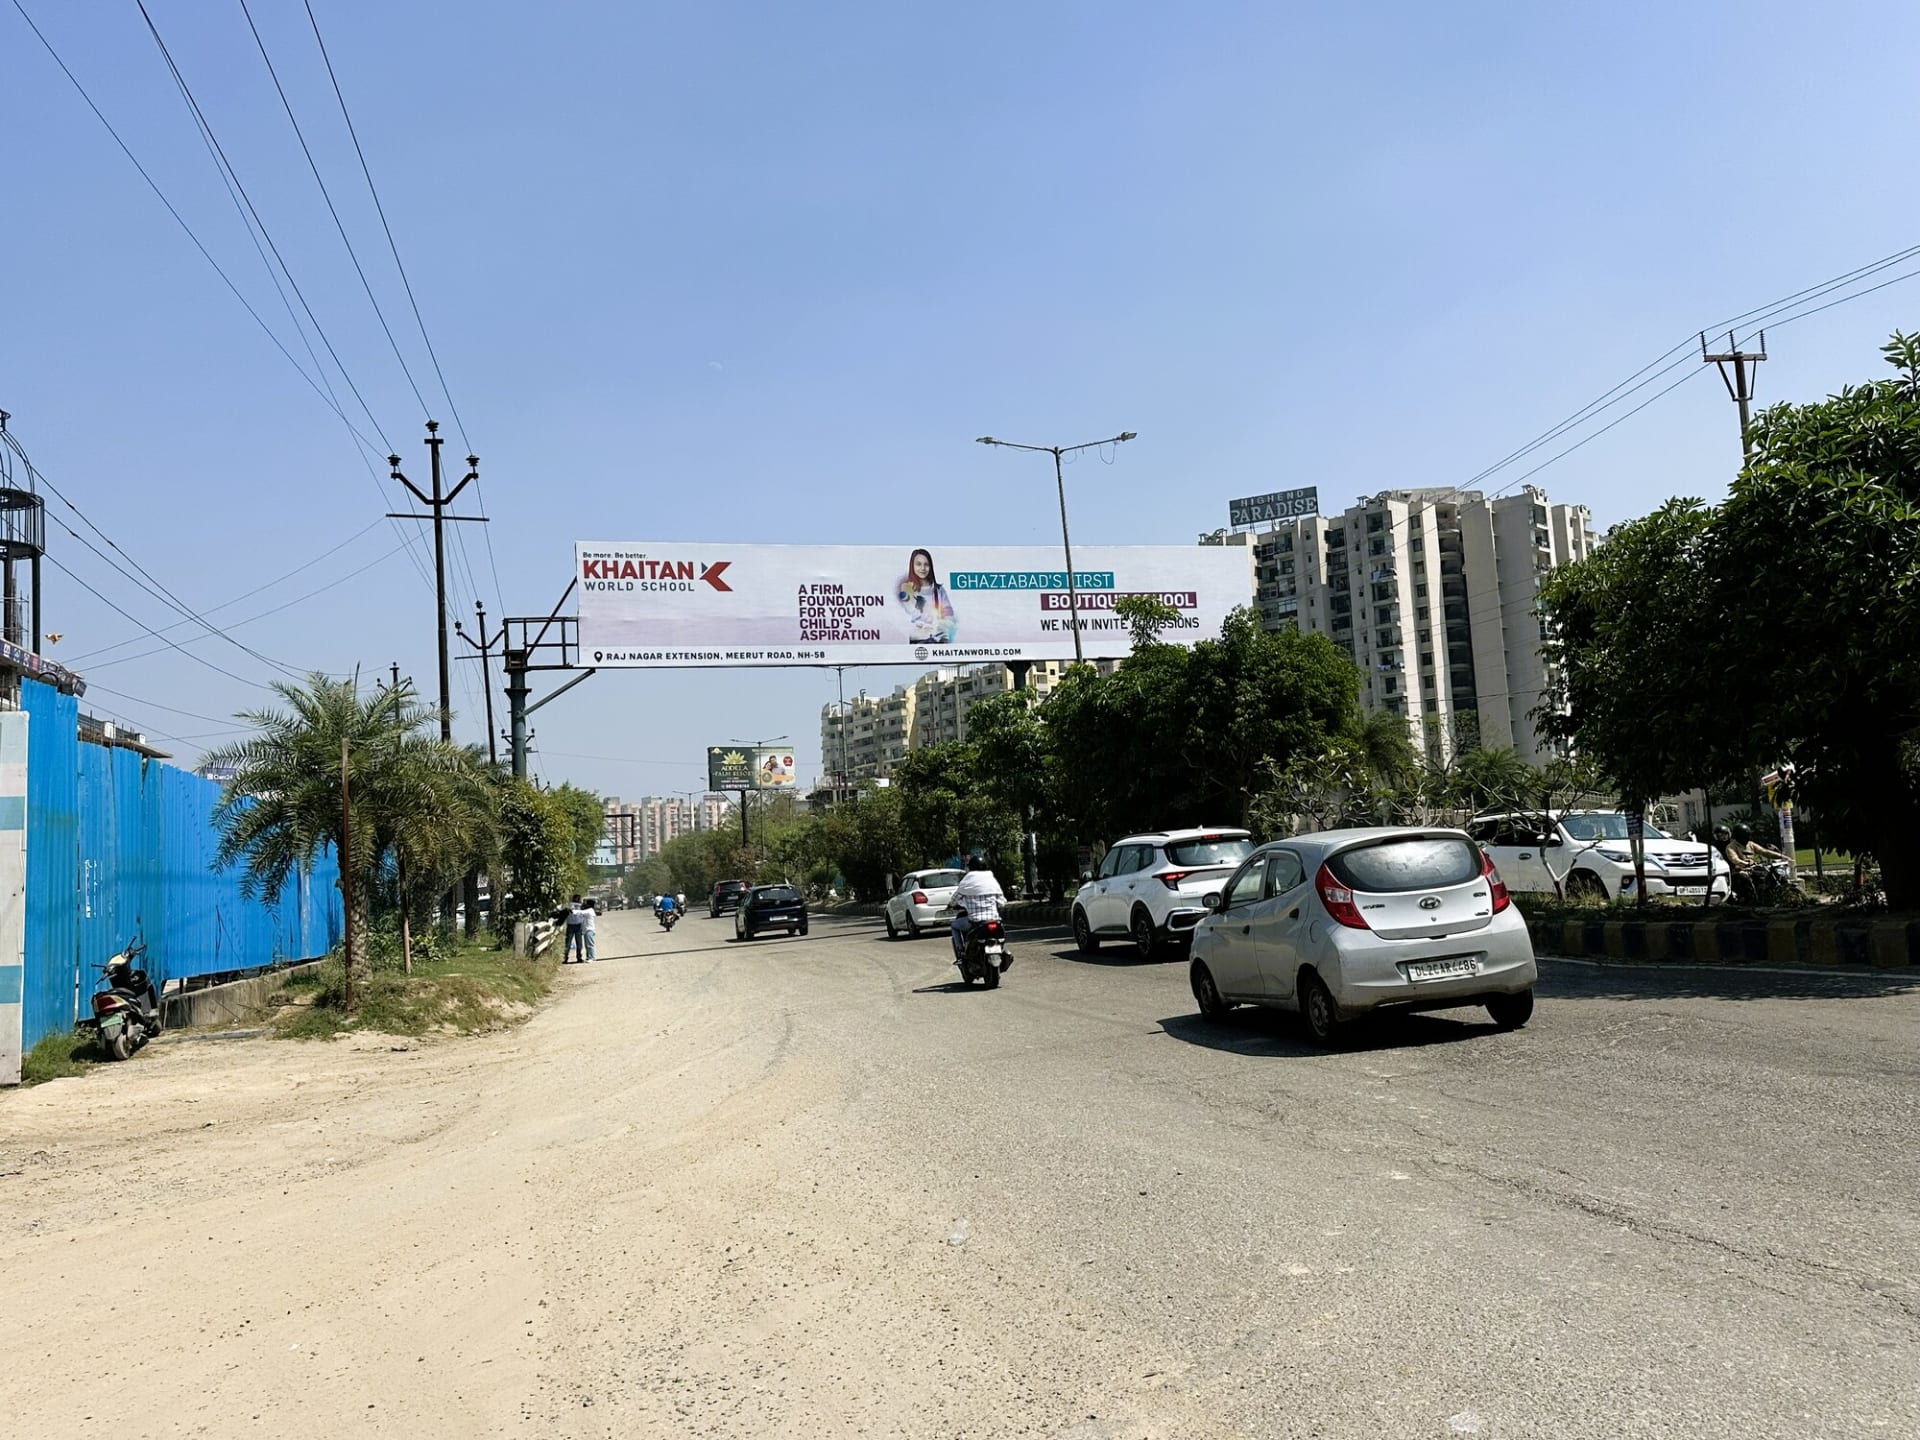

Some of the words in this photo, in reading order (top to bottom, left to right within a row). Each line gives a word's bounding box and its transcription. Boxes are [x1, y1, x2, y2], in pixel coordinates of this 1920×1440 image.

[1231, 497, 1317, 524] PARADISE
[625, 552, 649, 560] better.
[583, 560, 694, 580] KHAITAN
[584, 581, 634, 591] WORLD
[641, 581, 695, 592] SCHOOL
[956, 573, 1062, 589] GHAZIABAD'S
[798, 584, 808, 595] A
[811, 584, 844, 595] FIRM
[798, 595, 885, 607] FOUNDATION
[1132, 593, 1195, 607] HOOL
[800, 607, 826, 618] FOR
[830, 607, 865, 618] YOUR
[800, 618, 853, 629] CHILD'S
[1040, 619, 1060, 631] WE
[1092, 618, 1128, 630] INVITE
[1131, 616, 1200, 630] ISSIONS
[800, 629, 881, 641] ASPIRATION
[606, 652, 626, 661] RAJ
[629, 652, 663, 660] NAGAR
[665, 651, 723, 662] EXTENSION,
[726, 651, 764, 660] MEERUT
[767, 651, 795, 661] ROAD,
[798, 650, 825, 660] NH-58
[932, 648, 1022, 657] KHAITANWORLD.COM
